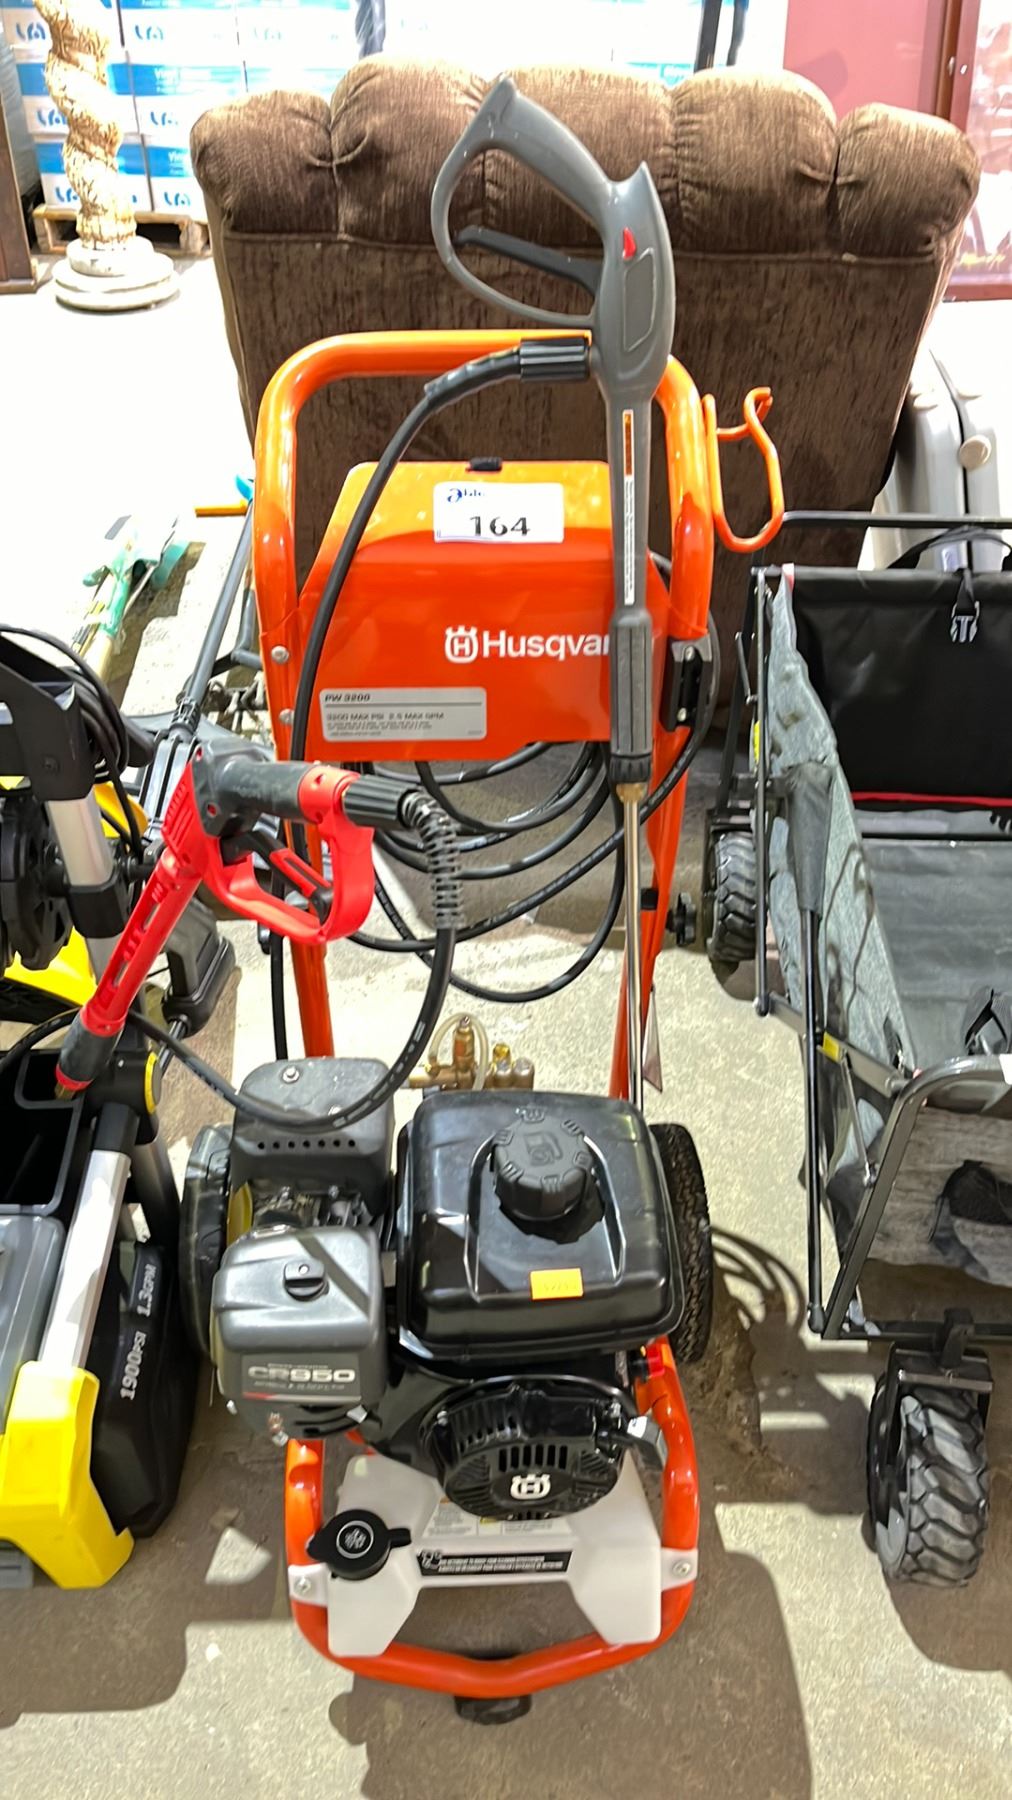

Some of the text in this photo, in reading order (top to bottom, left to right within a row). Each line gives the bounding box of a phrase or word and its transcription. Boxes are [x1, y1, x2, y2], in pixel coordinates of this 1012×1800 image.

[470, 516, 530, 537] 164
[325, 693, 371, 702] PW 3200
